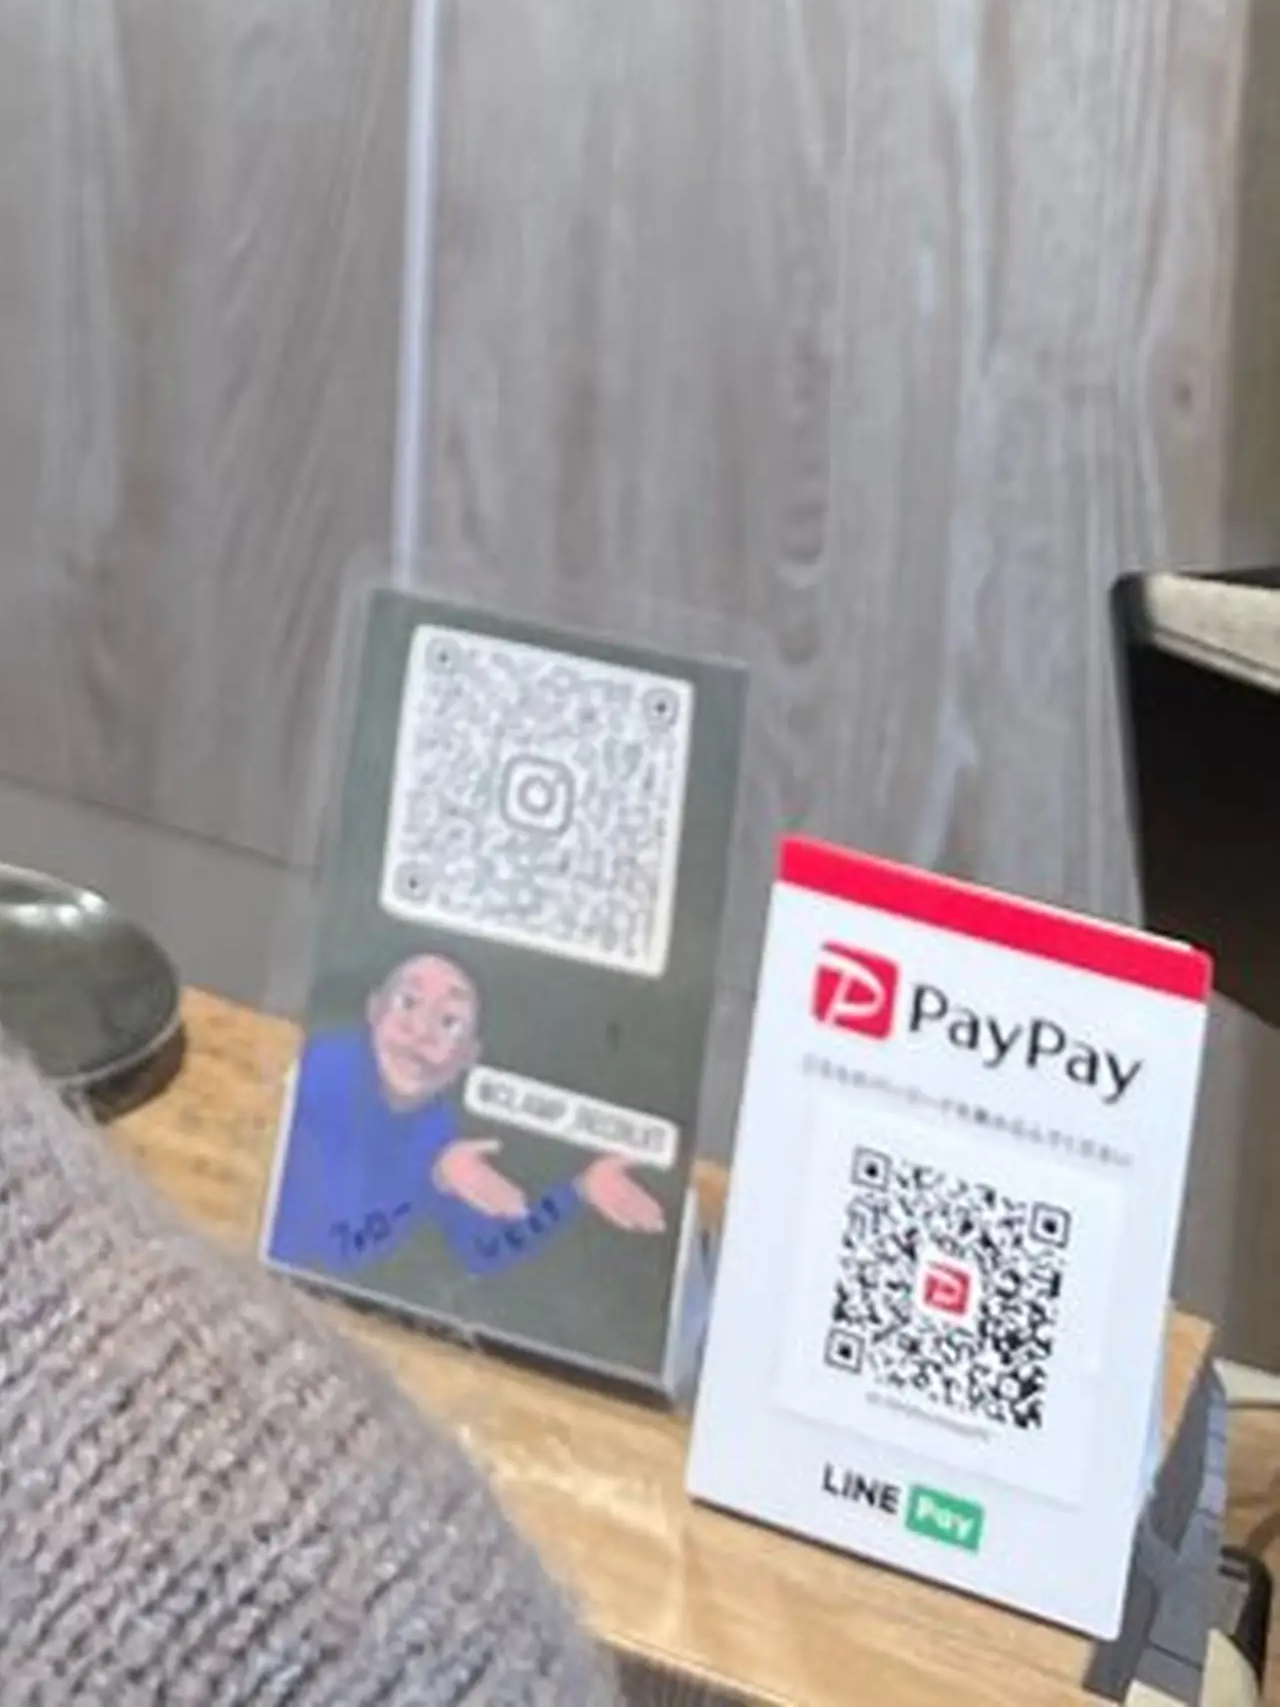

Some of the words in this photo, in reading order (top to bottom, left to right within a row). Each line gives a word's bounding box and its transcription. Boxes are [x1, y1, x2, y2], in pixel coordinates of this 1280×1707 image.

[908, 982, 1143, 1105] PayPay
[822, 1459, 901, 1516] LINE
[913, 1493, 976, 1542] Pay
